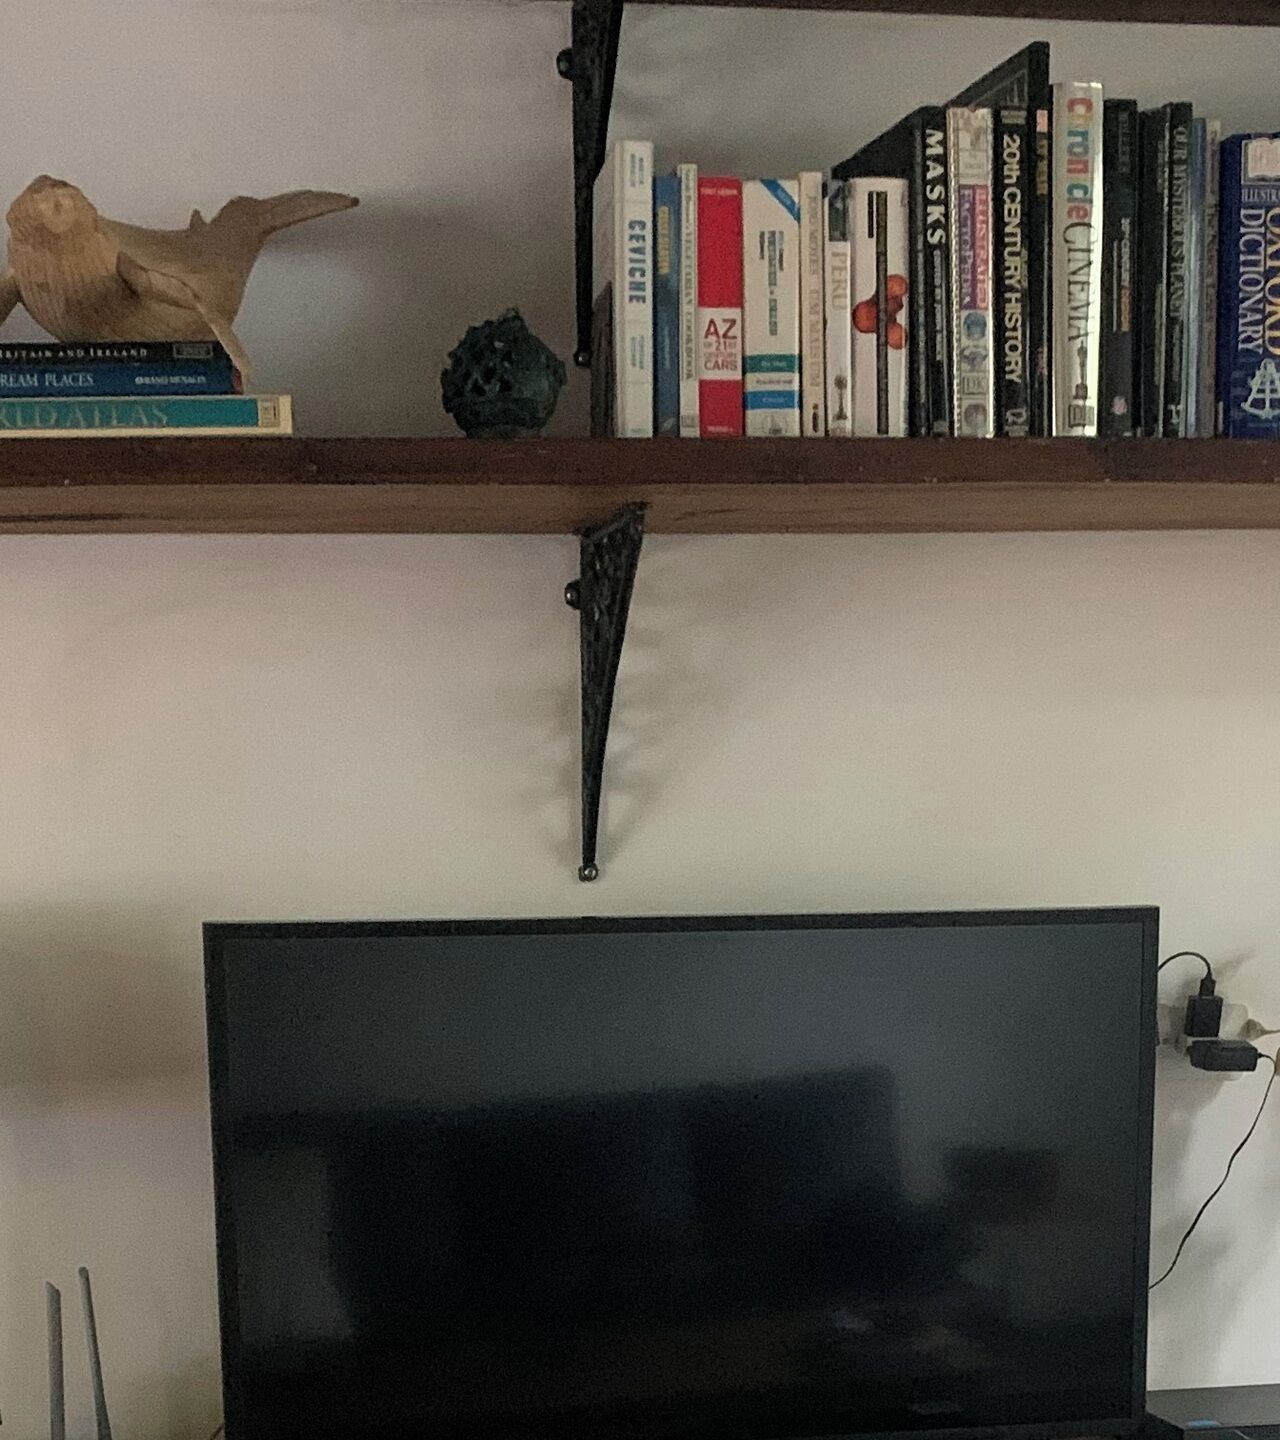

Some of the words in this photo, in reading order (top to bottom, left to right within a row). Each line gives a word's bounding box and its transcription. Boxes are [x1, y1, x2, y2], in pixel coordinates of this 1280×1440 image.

[925, 128, 946, 245] MASKS
[1002, 135, 1021, 184] 20th
[628, 219, 647, 304] CEVICHE
[1002, 189, 1021, 295] CENTURY
[831, 251, 848, 311] PERU
[1063, 220, 1097, 341] CINEMA
[1237, 208, 1264, 354] DICTIONARY
[90, 347, 148, 358] IRELAND
[704, 318, 738, 340] AZ
[1003, 298, 1022, 383] HISTORY
[45, 372, 95, 387] PLACES
[704, 360, 738, 371] CARS
[63, 403, 169, 428] ATLAS
